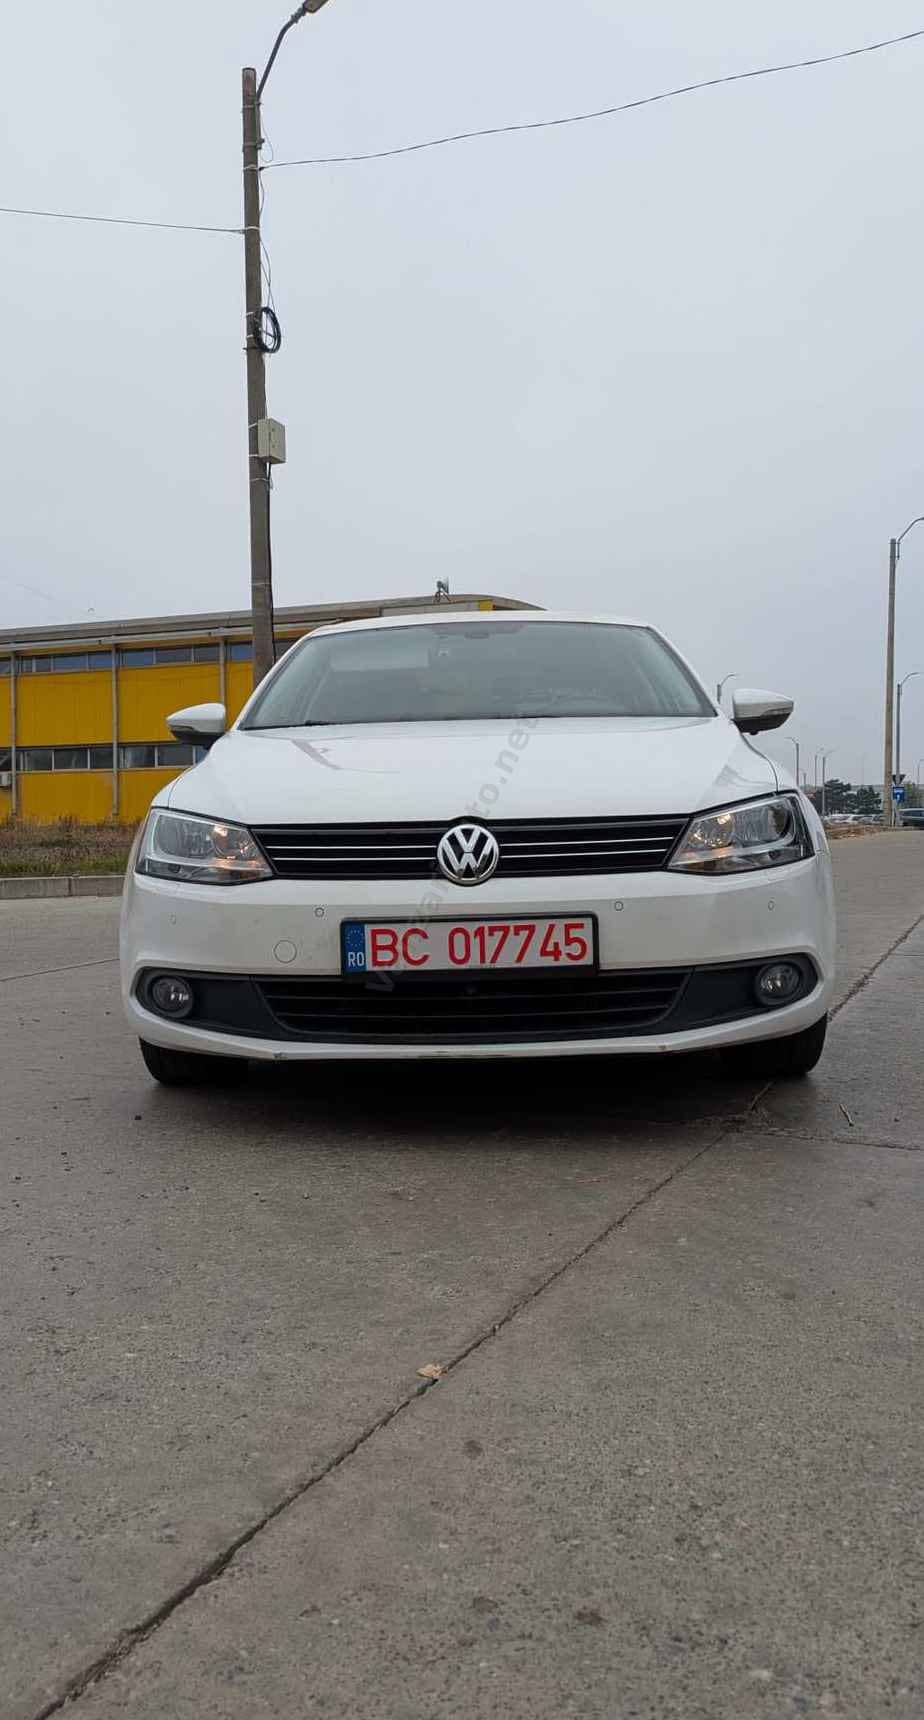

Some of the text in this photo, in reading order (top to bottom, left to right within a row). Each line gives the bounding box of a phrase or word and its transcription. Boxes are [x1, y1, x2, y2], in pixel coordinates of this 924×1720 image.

[348, 952, 365, 968] RO
[370, 923, 588, 967] BC 017745
